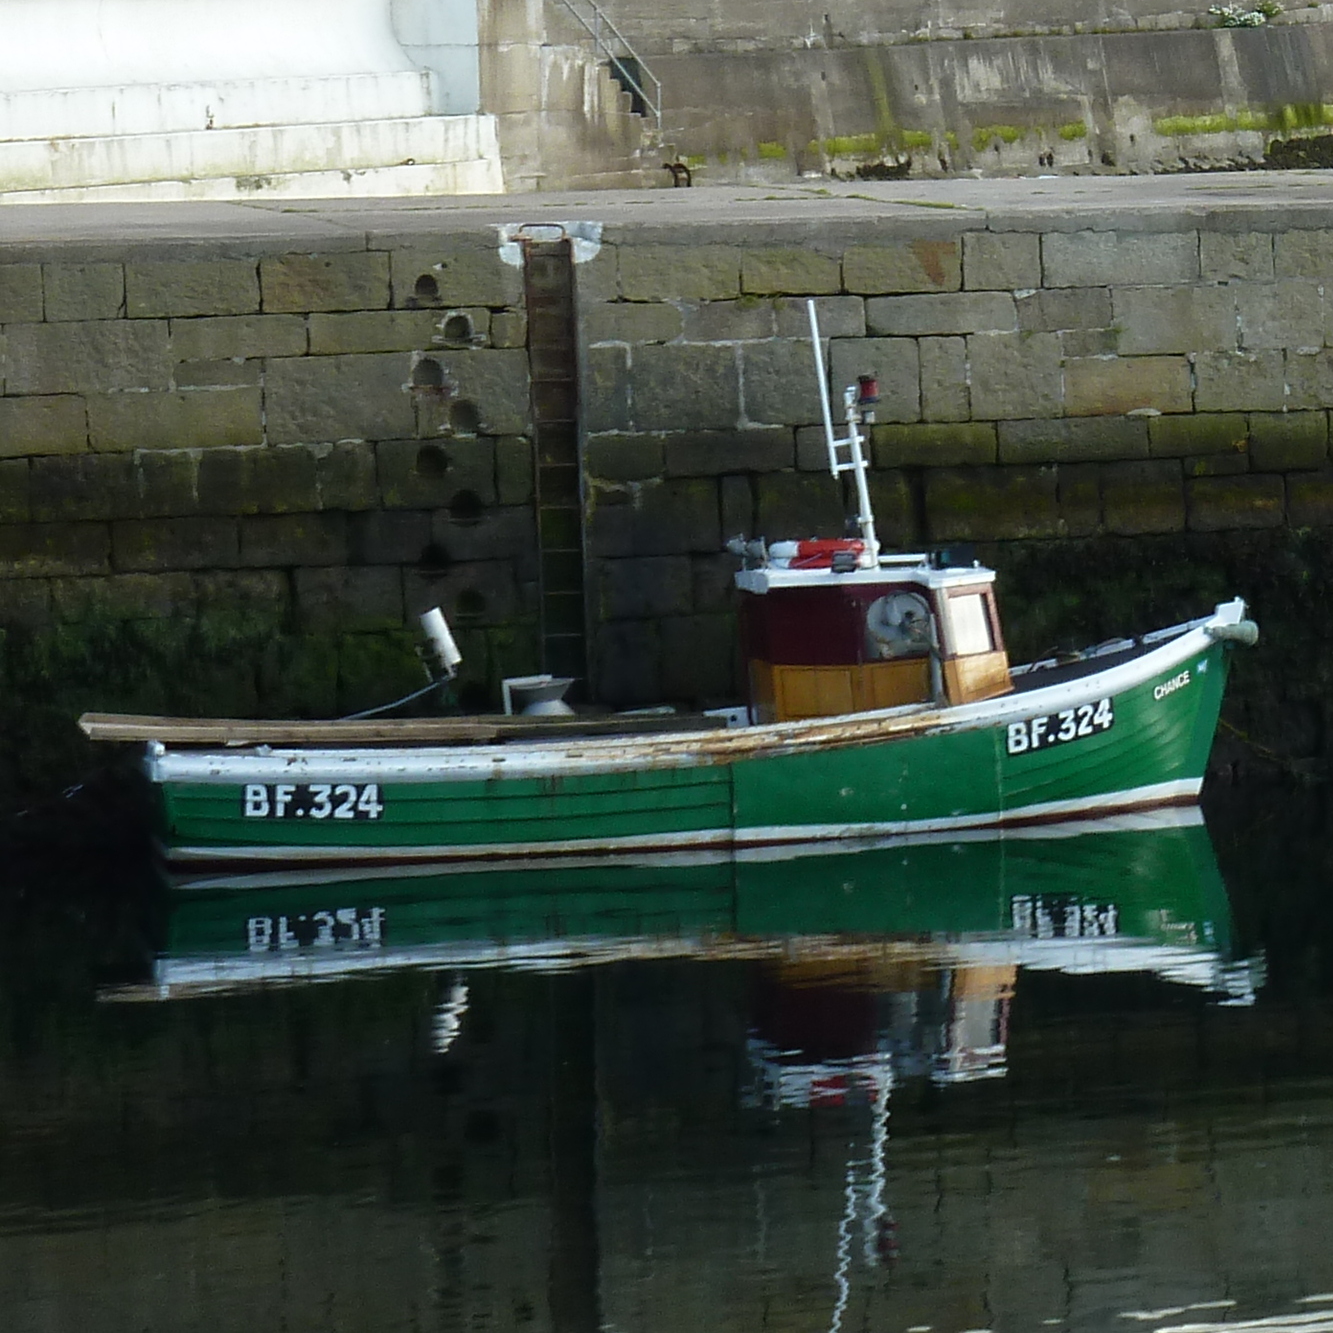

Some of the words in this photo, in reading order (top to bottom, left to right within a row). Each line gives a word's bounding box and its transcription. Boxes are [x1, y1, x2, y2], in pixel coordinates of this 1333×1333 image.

[1153, 670, 1191, 700] CHANCE
[1007, 697, 1113, 755] BF.324
[244, 783, 384, 819] BF.324
